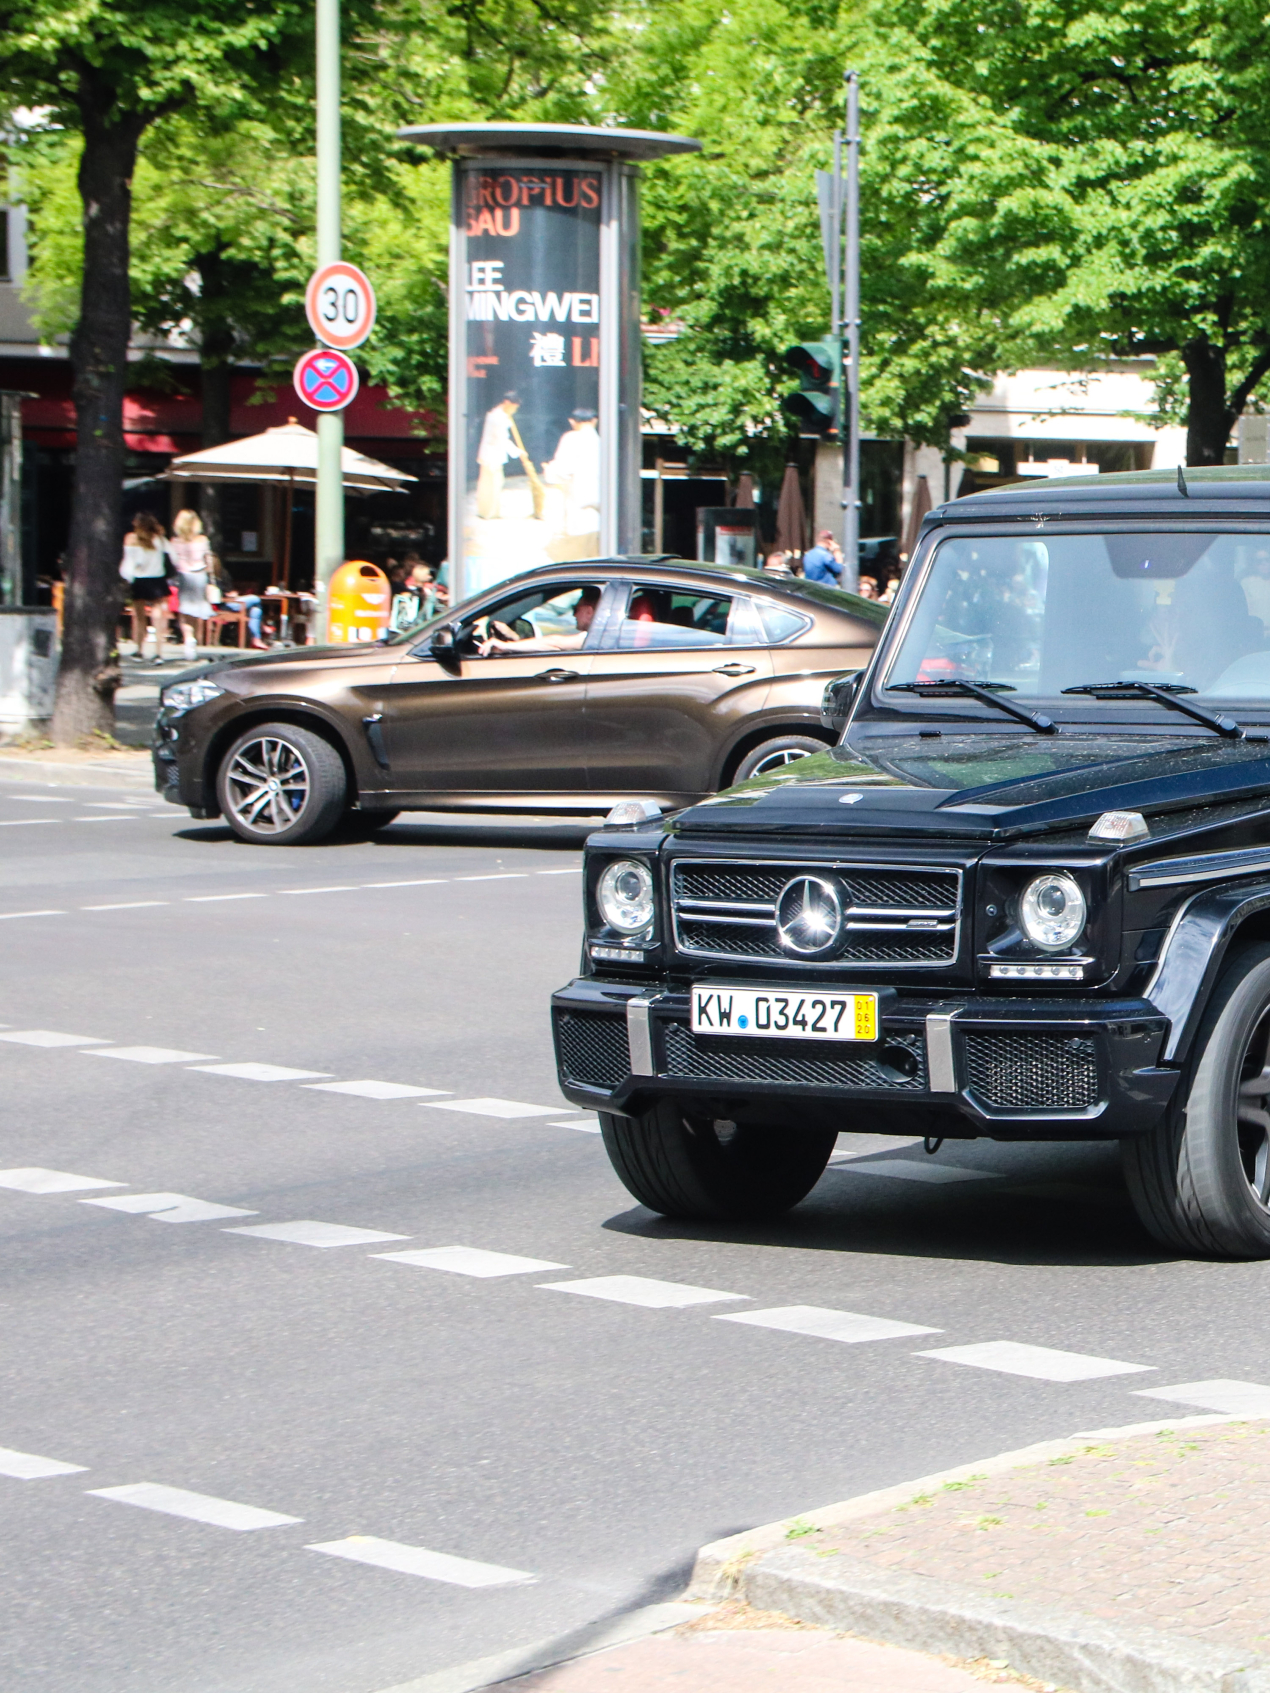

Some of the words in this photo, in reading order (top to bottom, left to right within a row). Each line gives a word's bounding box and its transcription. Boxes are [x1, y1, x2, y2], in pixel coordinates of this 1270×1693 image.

[323, 287, 358, 323] 30
[857, 1000, 869, 1011] 01
[698, 993, 733, 1027] KW
[755, 996, 847, 1033] 03427
[857, 1013, 870, 1022] 06
[857, 1025, 870, 1034] 20
